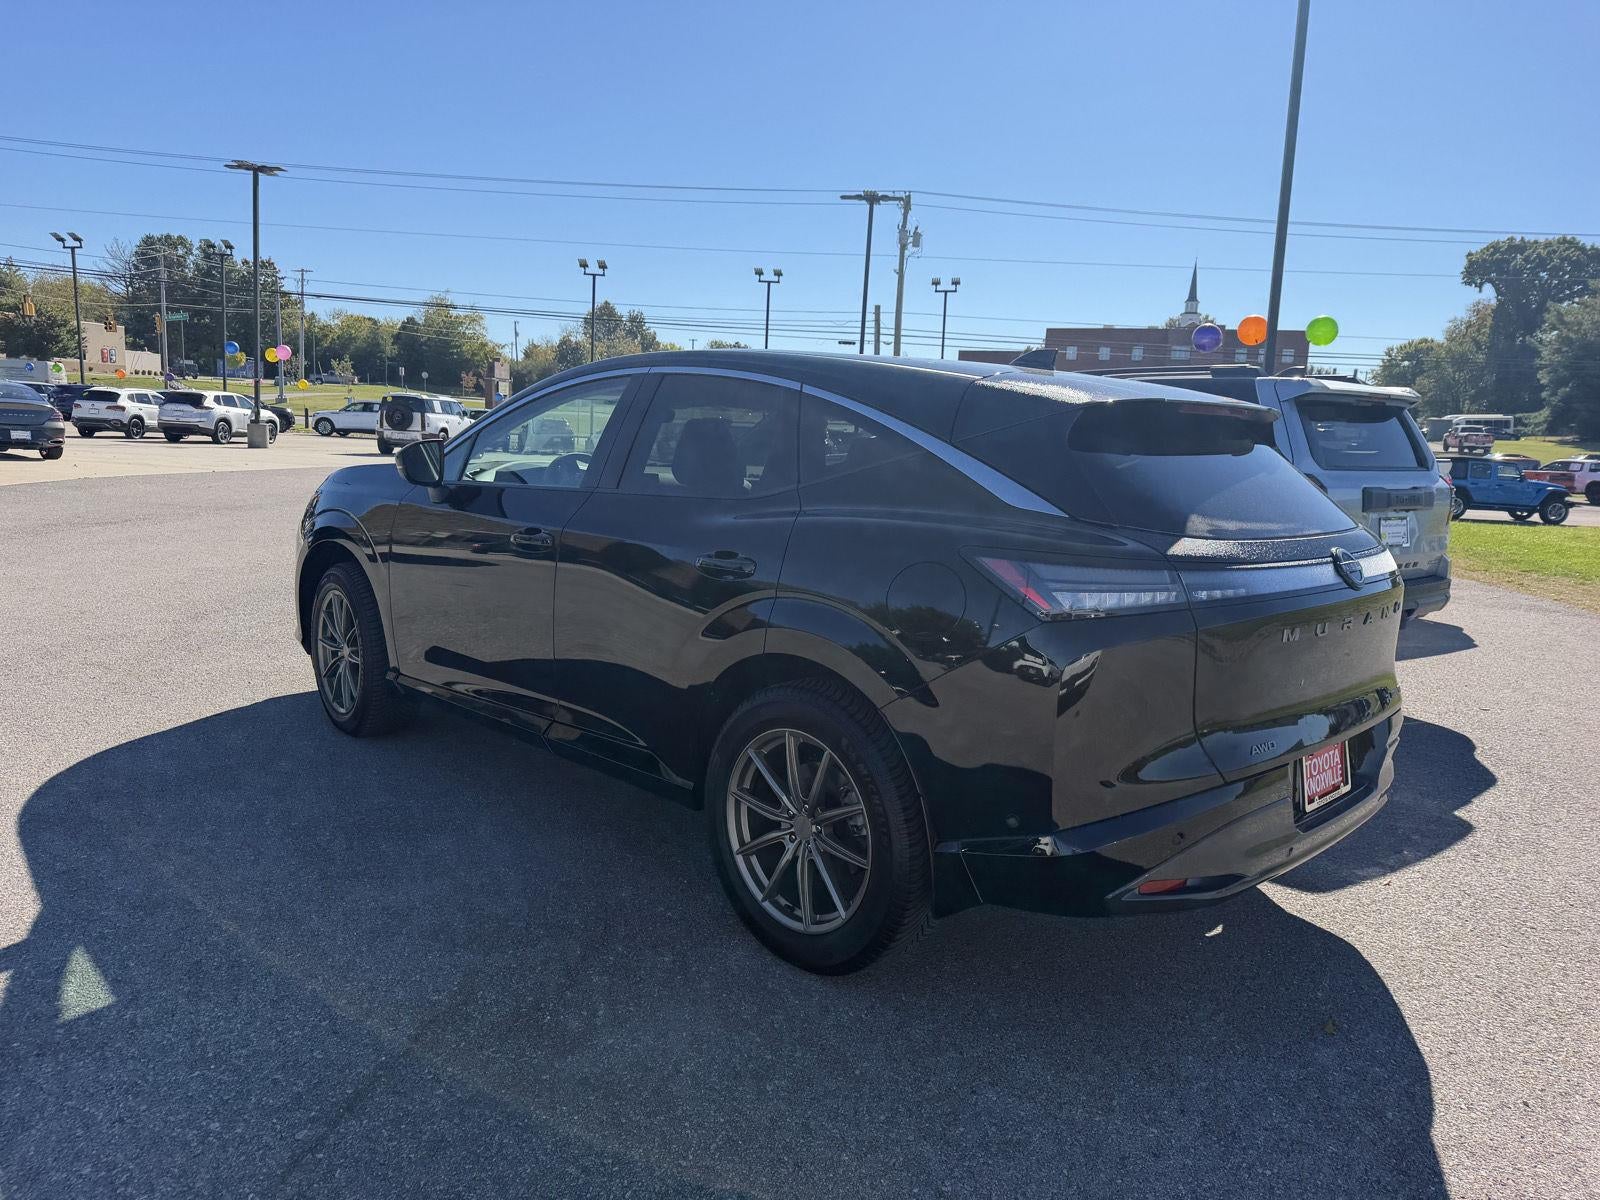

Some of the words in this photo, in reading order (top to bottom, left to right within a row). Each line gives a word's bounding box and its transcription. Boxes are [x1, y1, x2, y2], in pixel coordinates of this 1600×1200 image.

[1282, 601, 1400, 643] MURANO
[1250, 740, 1277, 756] AWD
[1305, 749, 1341, 778] TOYOTA
[1307, 764, 1343, 797] KNOXVILLE
